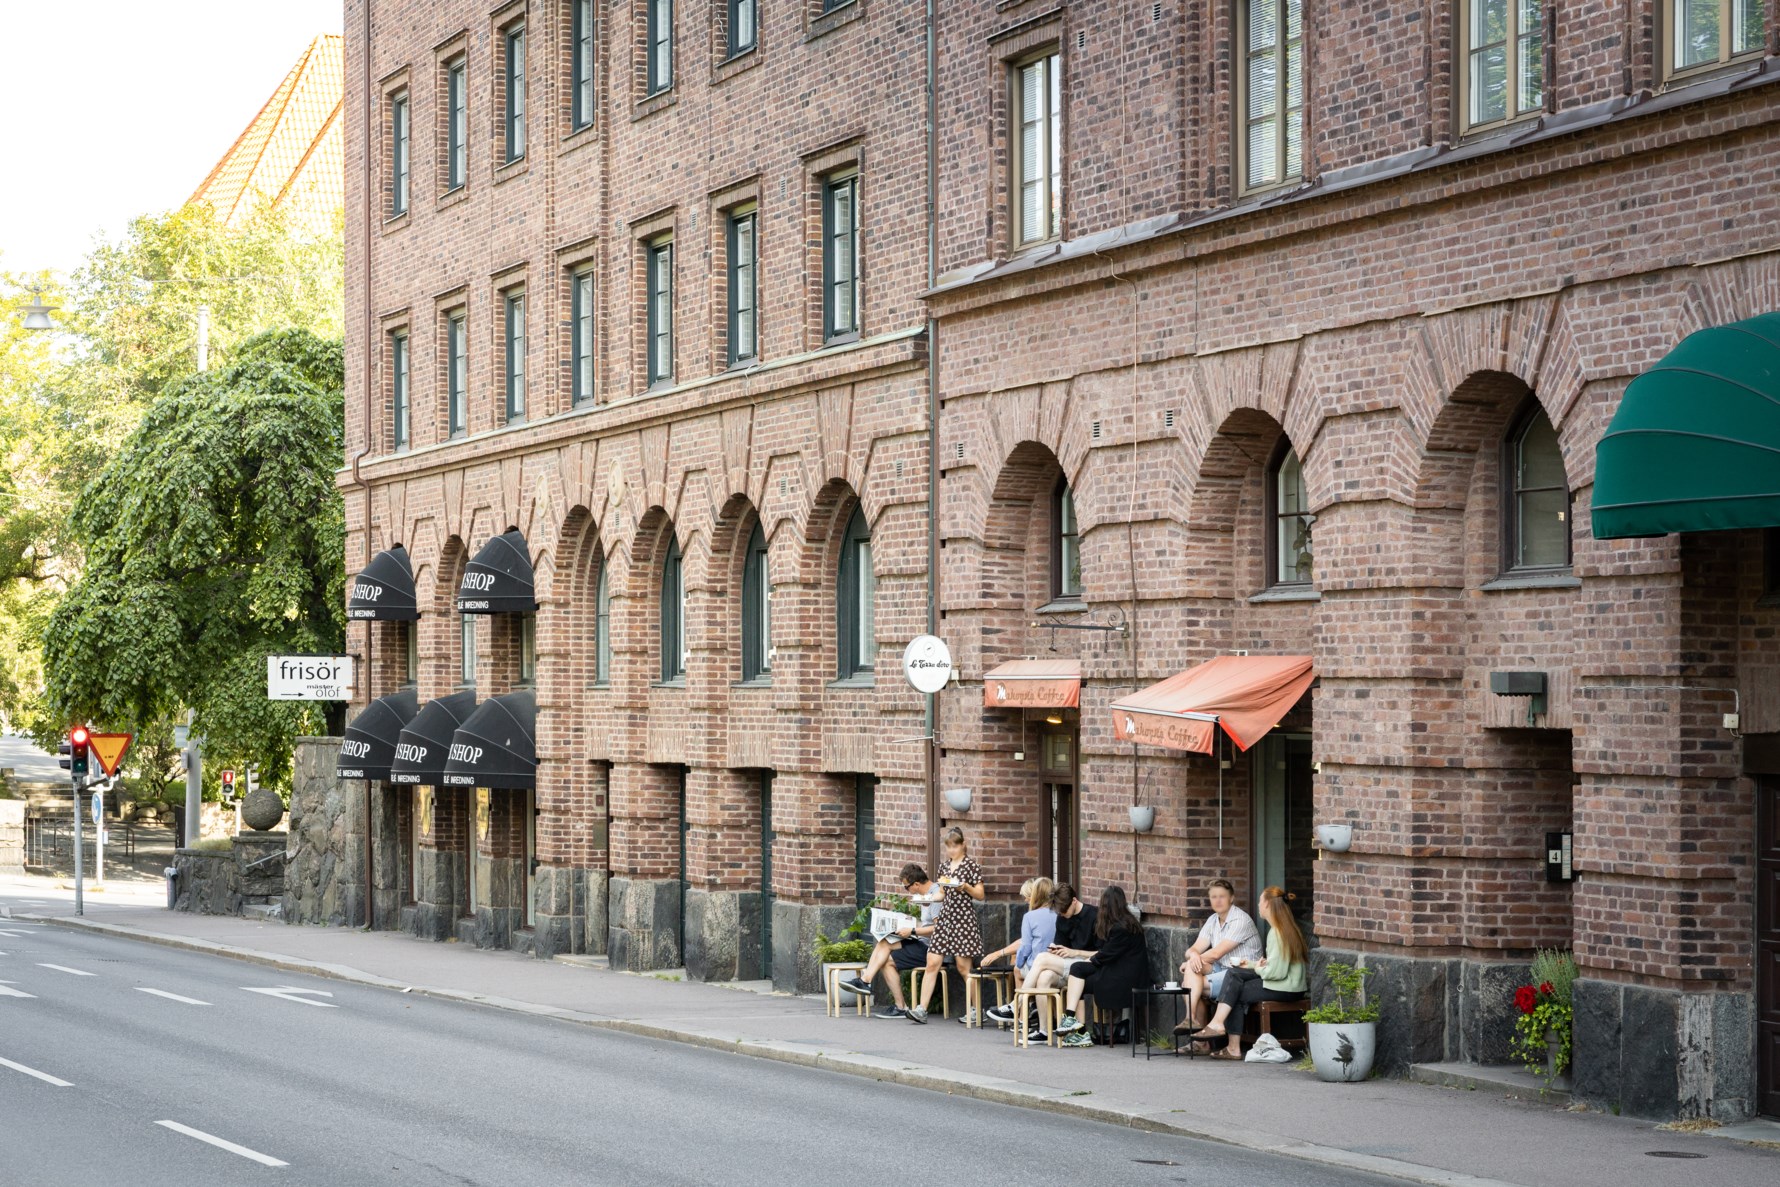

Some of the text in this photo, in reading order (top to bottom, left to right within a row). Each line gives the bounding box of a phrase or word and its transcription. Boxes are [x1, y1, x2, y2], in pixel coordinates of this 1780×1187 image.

[280, 660, 341, 680] frisör
[1037, 686, 1065, 704] Coffee
[1167, 724, 1199, 747] Coffee
[1551, 851, 1559, 862] 4
